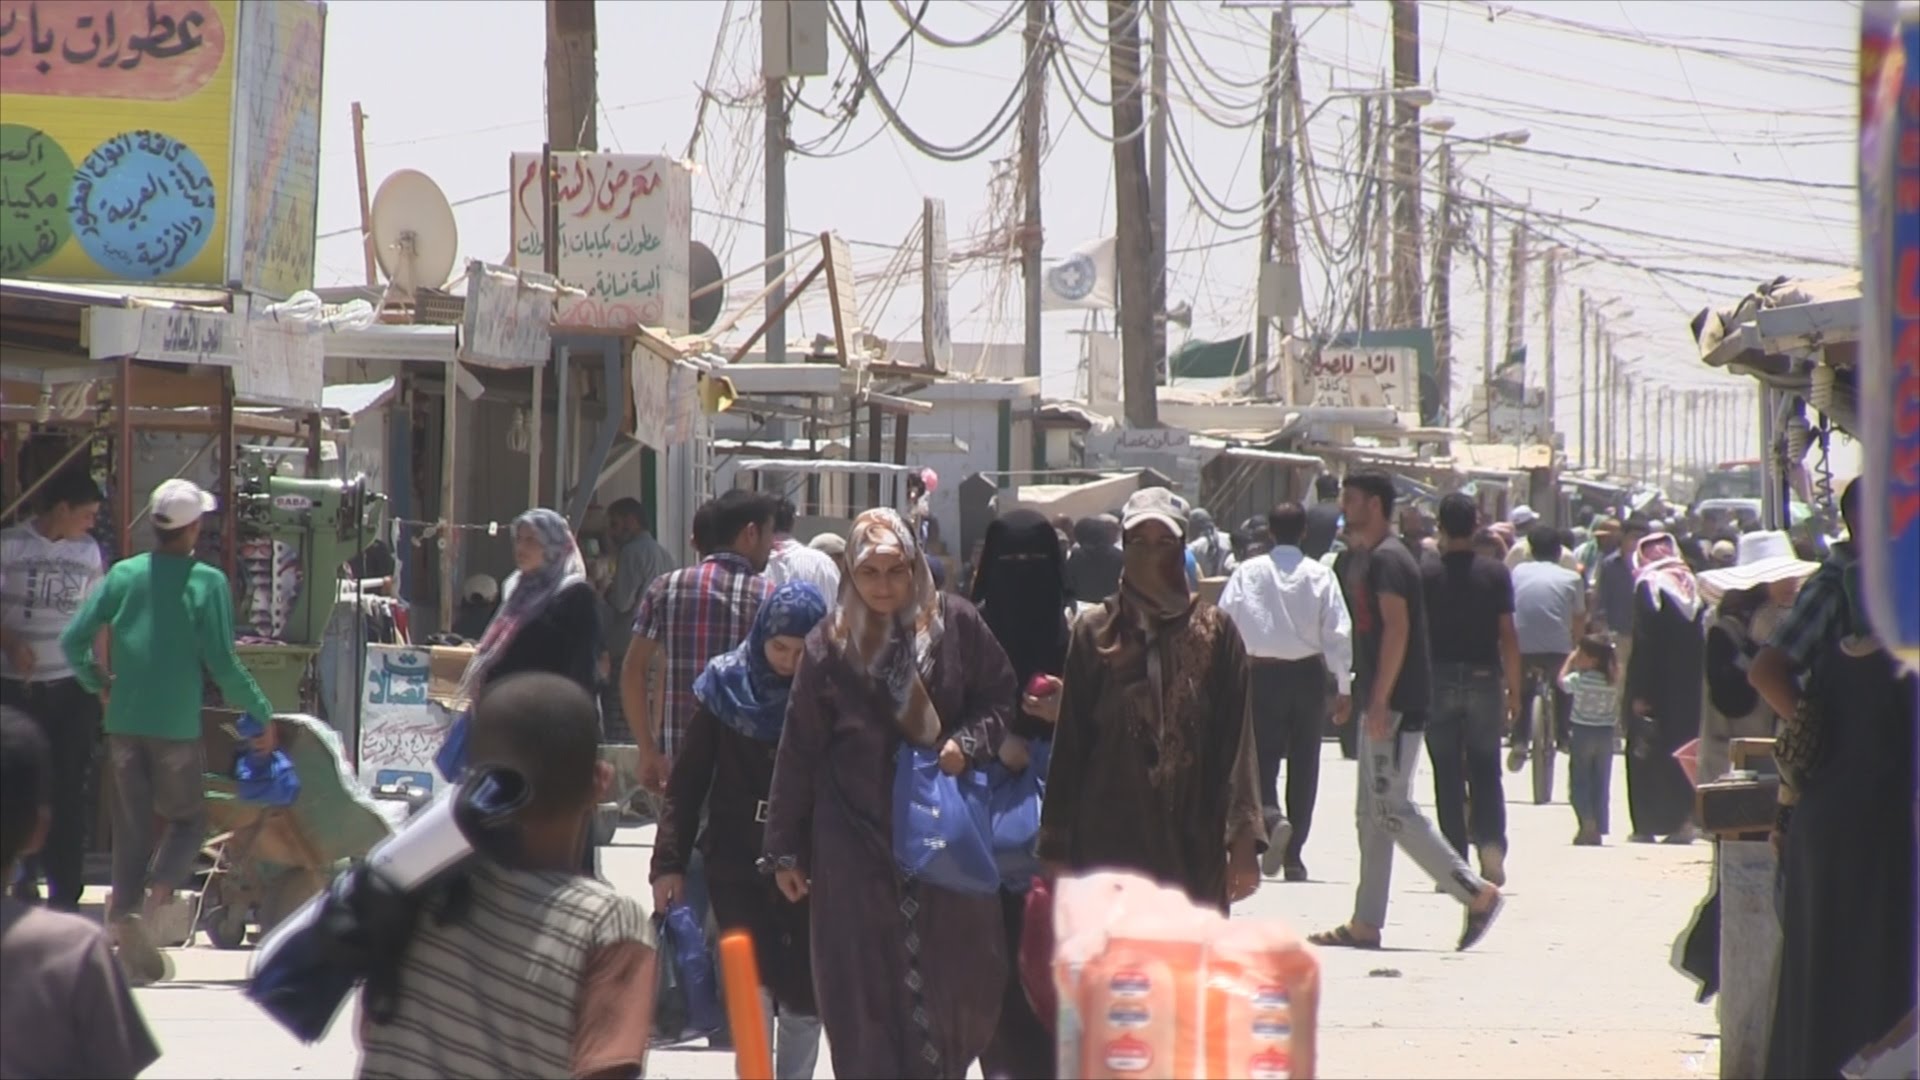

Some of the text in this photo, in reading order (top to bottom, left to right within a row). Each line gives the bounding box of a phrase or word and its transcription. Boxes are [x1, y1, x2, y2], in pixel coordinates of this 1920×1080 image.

[0, 1, 205, 75] عطورات بار
[138, 130, 187, 162] كافة
[0, 171, 58, 219] مكيا
[66, 169, 100, 237] العطور
[99, 171, 169, 232] العربية
[597, 159, 663, 220] معرض
[617, 223, 661, 256] عطورات
